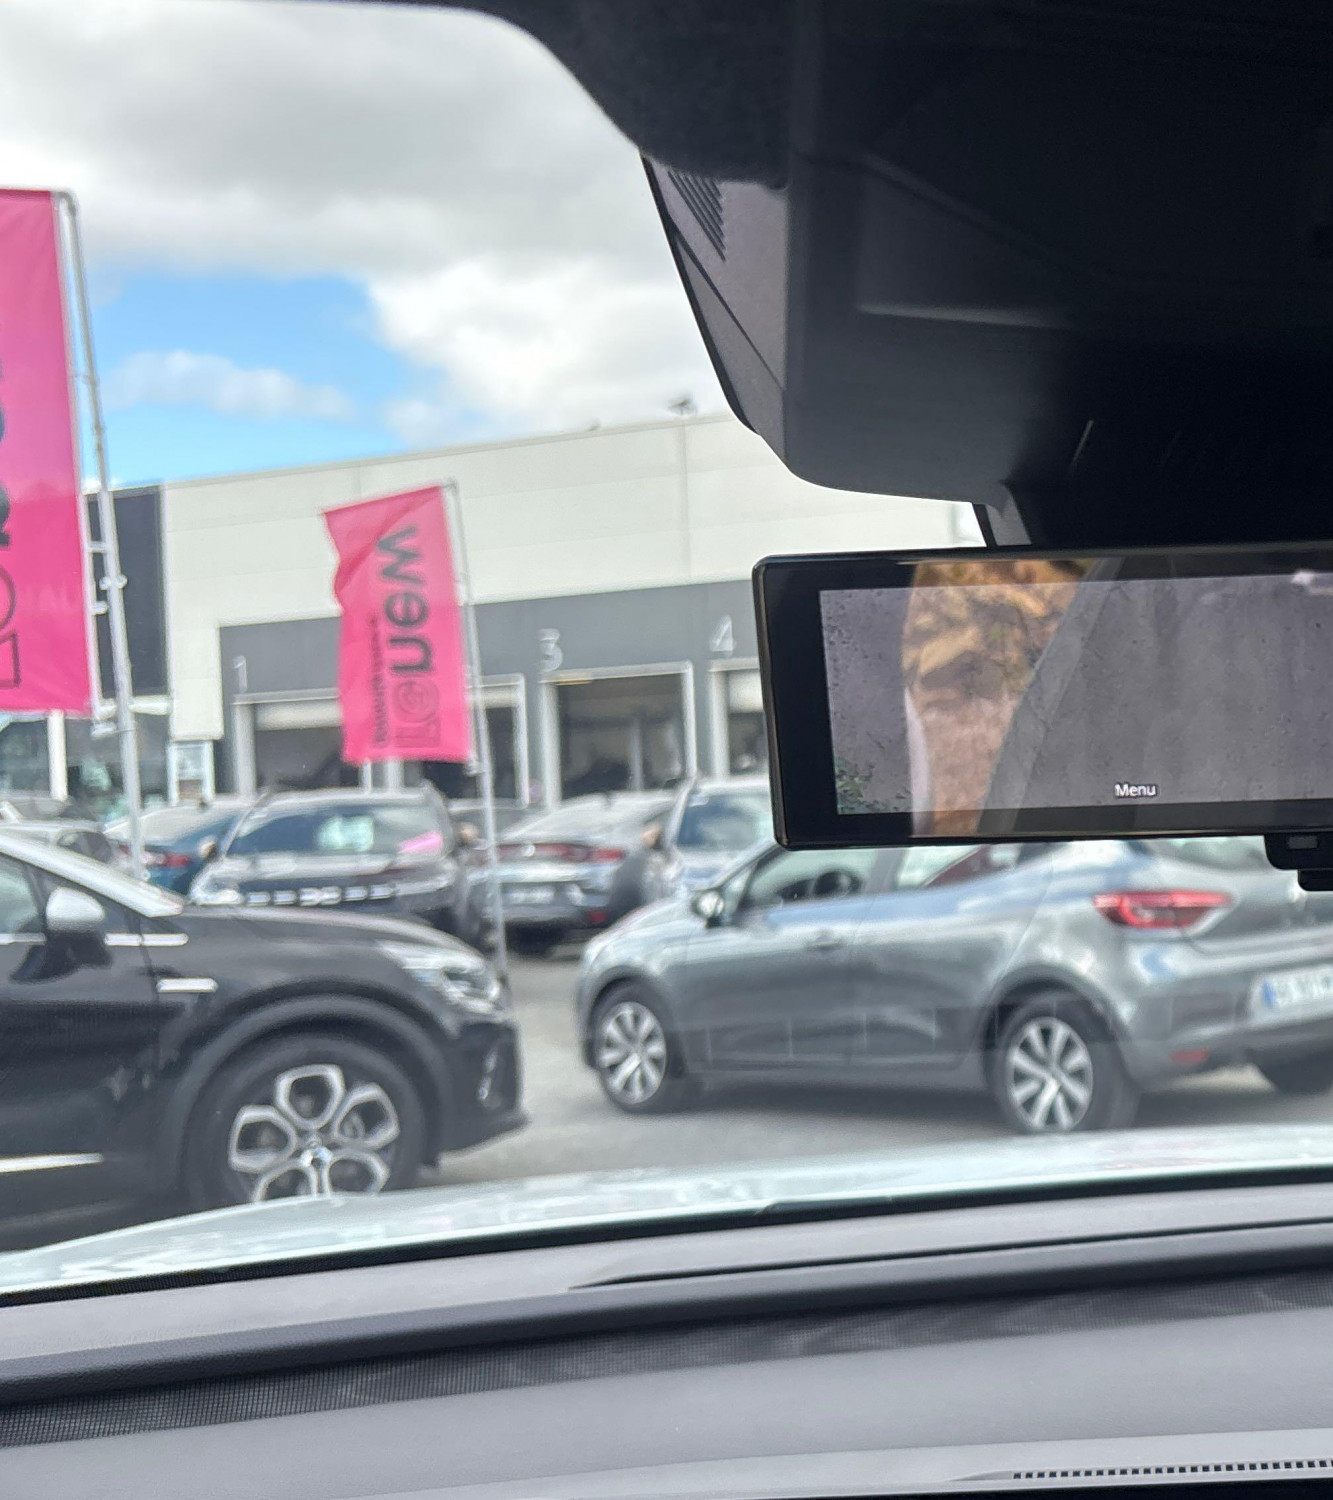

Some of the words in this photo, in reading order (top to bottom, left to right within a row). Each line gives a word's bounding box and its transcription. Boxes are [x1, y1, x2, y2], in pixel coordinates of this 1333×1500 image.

[538, 628, 563, 672] 3
[711, 616, 737, 656] 4
[233, 656, 248, 693] 1
[1114, 783, 1157, 797] Menu
